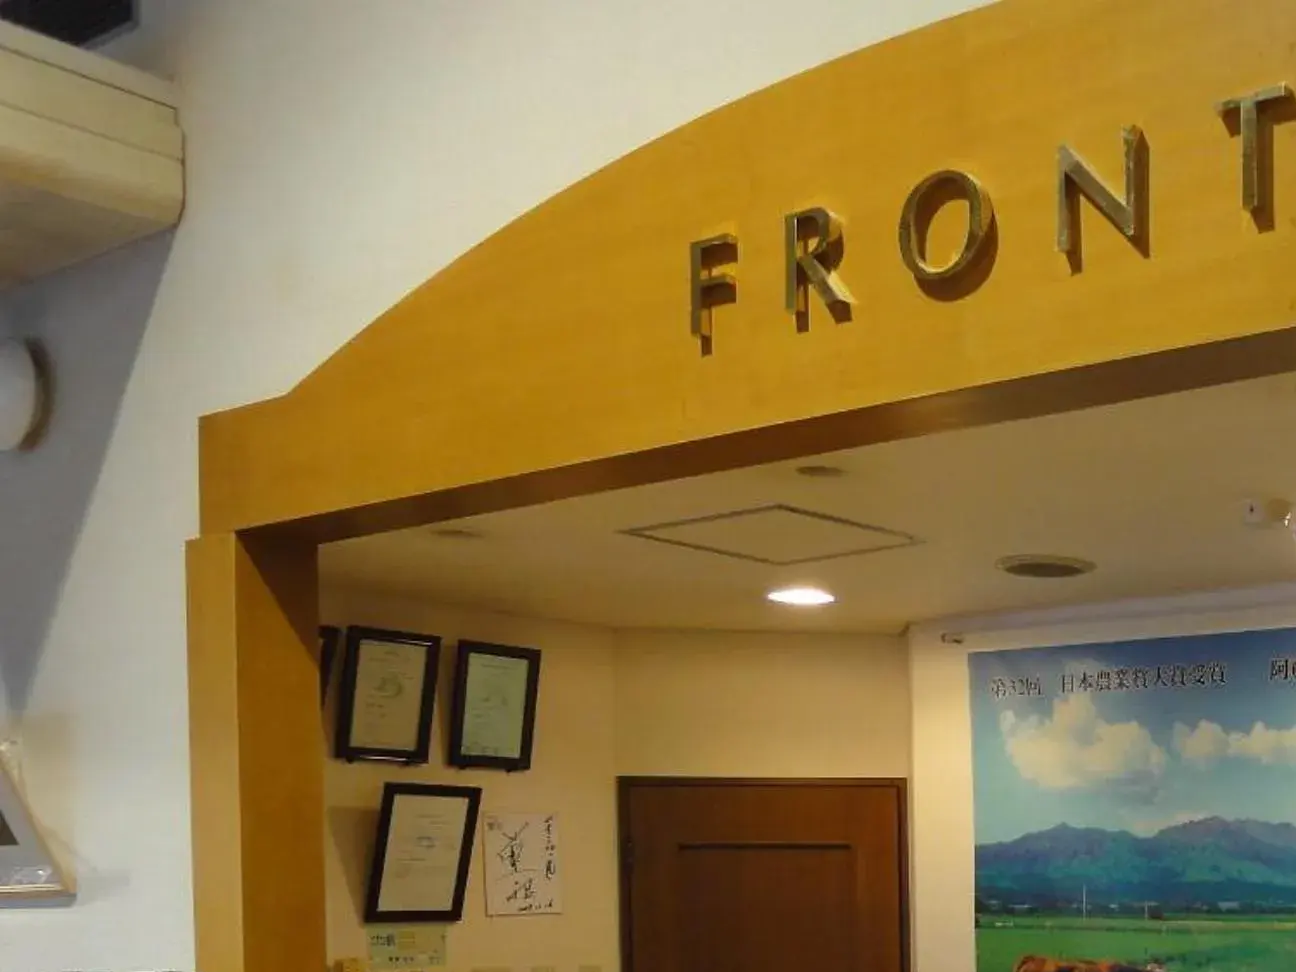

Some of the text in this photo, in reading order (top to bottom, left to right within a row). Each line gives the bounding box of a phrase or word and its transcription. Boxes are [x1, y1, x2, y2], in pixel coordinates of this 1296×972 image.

[991, 676, 1043, 699] 第32回
[1060, 660, 1228, 694] 日本農業賞大賞受賞
